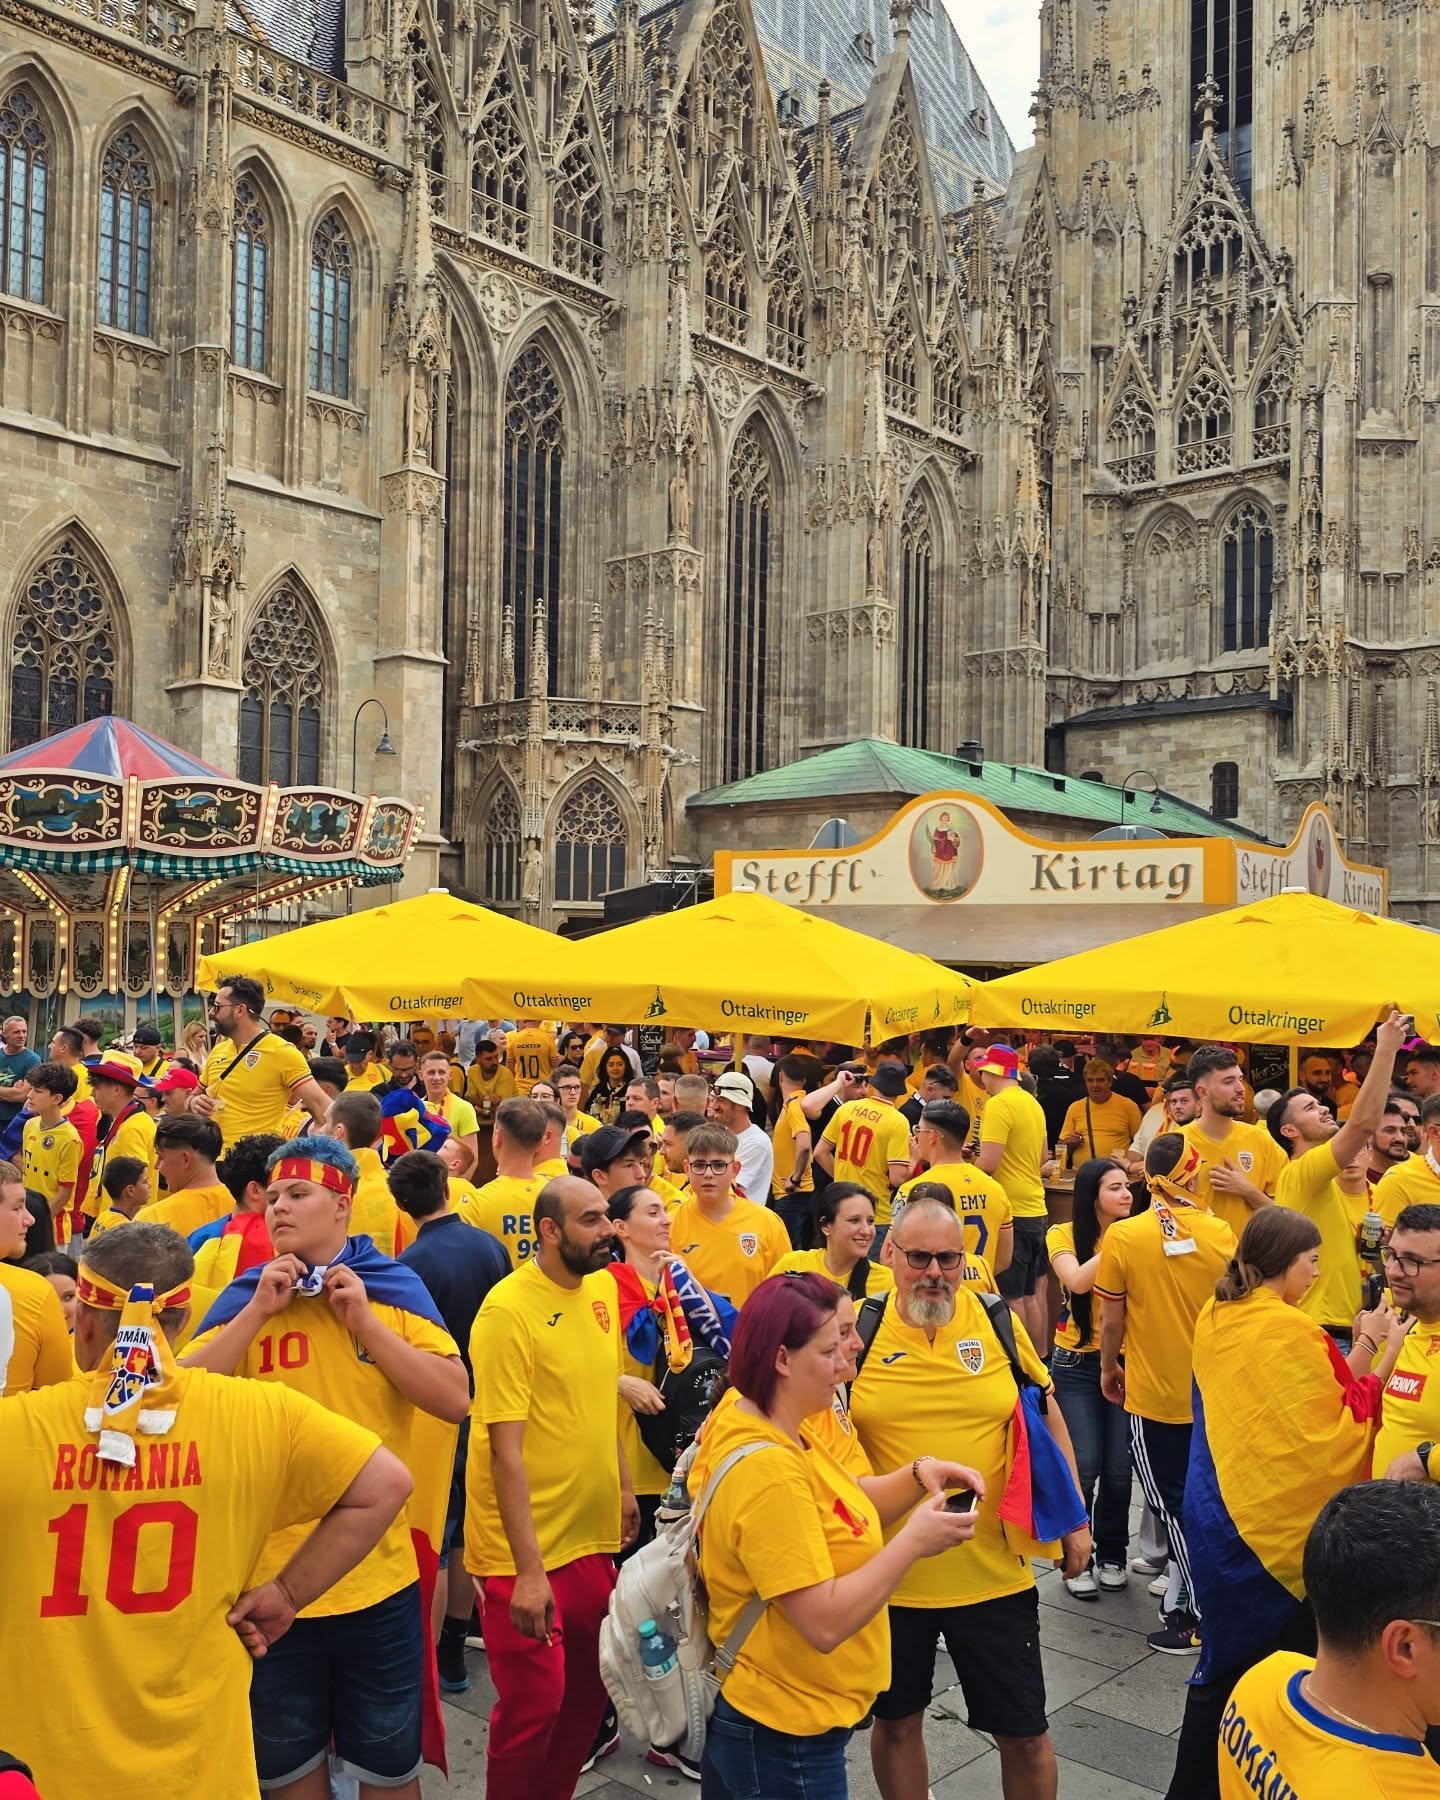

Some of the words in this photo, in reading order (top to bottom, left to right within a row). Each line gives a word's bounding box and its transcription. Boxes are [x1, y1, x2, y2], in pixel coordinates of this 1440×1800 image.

[742, 858, 864, 904] Steffl
[1029, 853, 1194, 900] Kirtag
[1343, 870, 1381, 915] Kirtag
[389, 995, 463, 1011] Ottakringer
[513, 991, 593, 1011] Ottakringer
[721, 1000, 809, 1026] Ottakringer
[1021, 998, 1097, 1019] Ottakringer
[1228, 1005, 1325, 1034] Ottakringer
[519, 1055, 540, 1079] 10
[850, 1105, 883, 1124] HAGI
[838, 1119, 874, 1168] 10
[960, 1194, 987, 1211] EMY
[502, 1214, 532, 1235] RE
[116, 1328, 150, 1346] OMÂN
[258, 1330, 309, 1374] 10
[52, 1440, 202, 1491] ROMANIA
[39, 1500, 199, 1618] 10
[1219, 1700, 1298, 1800] ROMÂN
